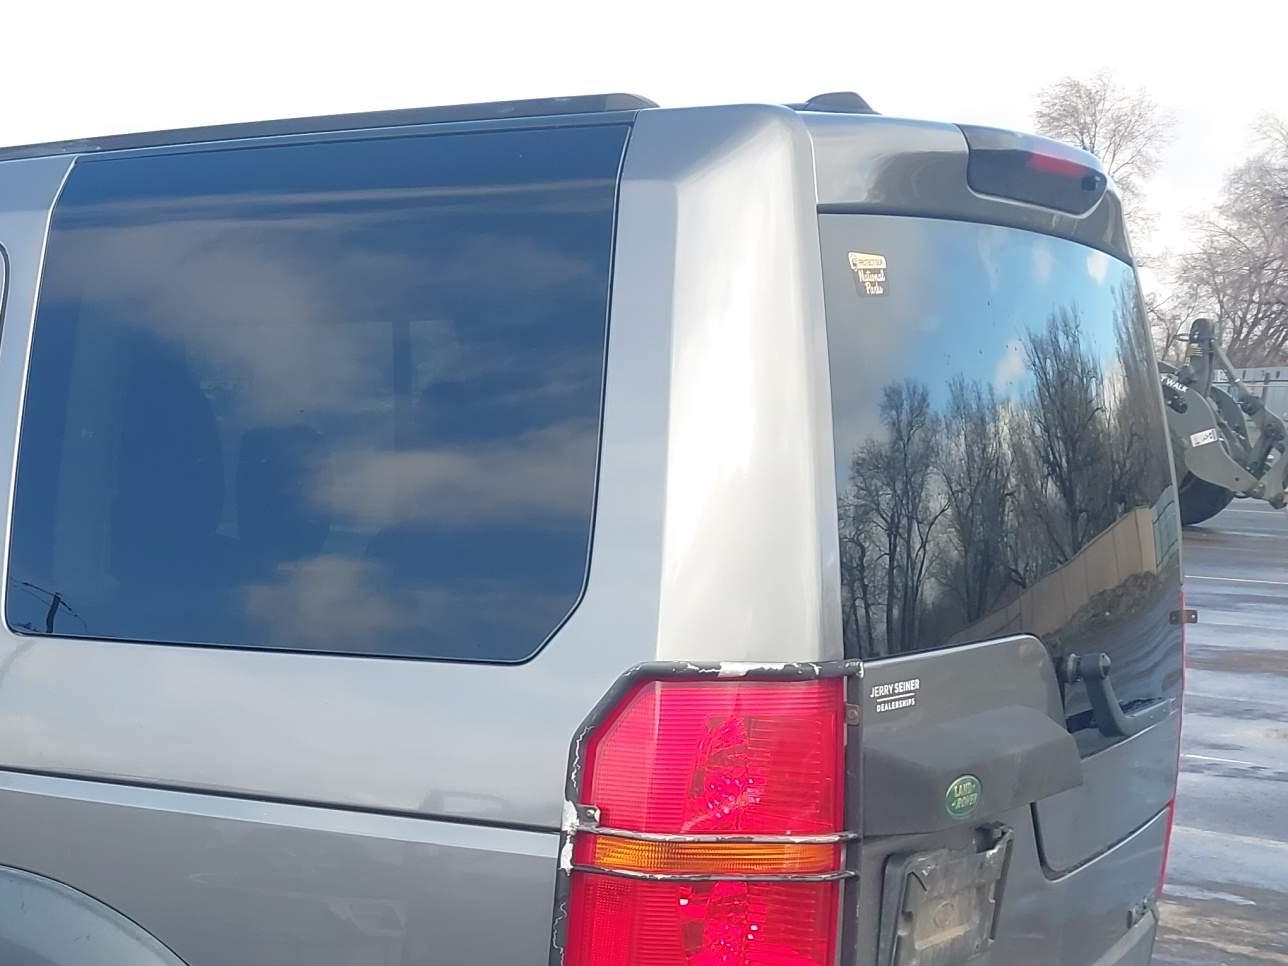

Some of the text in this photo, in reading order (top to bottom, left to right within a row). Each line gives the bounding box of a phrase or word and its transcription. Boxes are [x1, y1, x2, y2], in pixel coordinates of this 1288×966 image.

[858, 269, 886, 282] National
[865, 281, 884, 295] Parks
[870, 679, 920, 698] JERRY SEINER
[876, 698, 916, 712] DEALERSHIPS
[954, 782, 973, 798] LAND
[956, 793, 978, 809] ROVER
